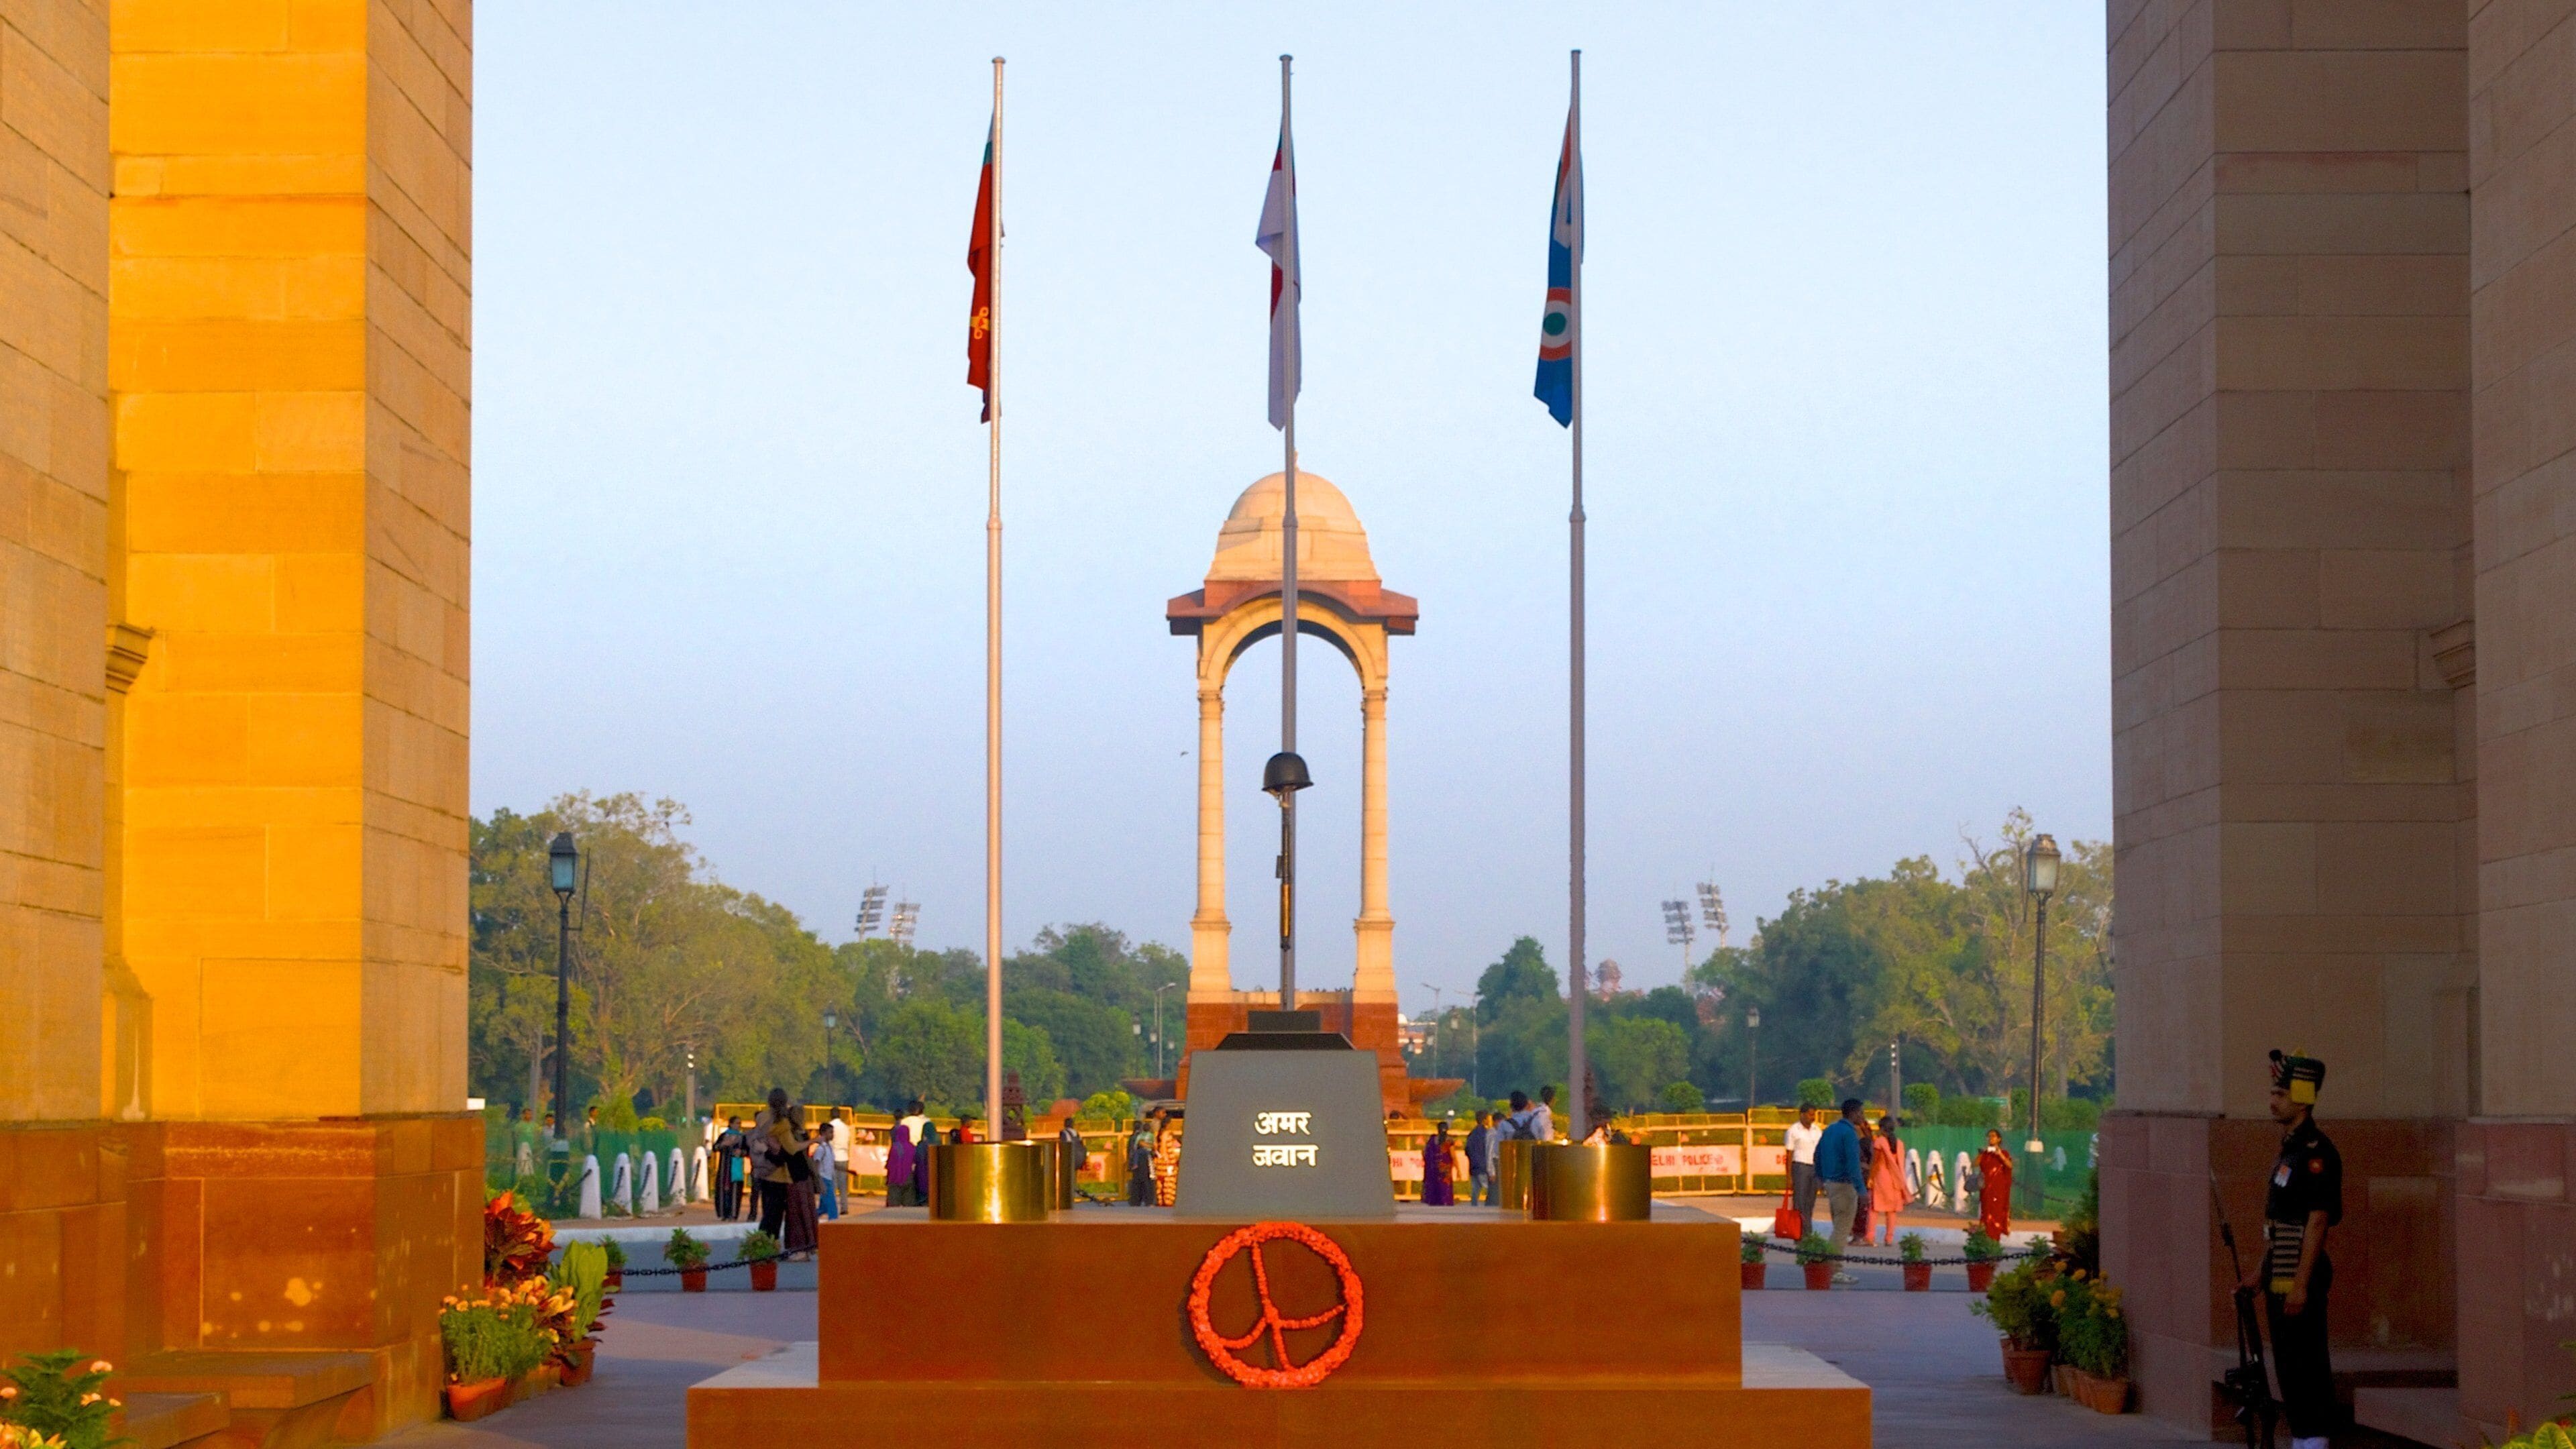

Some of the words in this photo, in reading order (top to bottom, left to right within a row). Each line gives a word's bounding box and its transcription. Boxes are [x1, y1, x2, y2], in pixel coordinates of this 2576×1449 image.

[1254, 1112, 1311, 1135] अमर
[1252, 1144, 1319, 1167] जवान
[1651, 1154, 1675, 1166] ELHI
[1682, 1154, 1712, 1165] POLICE
